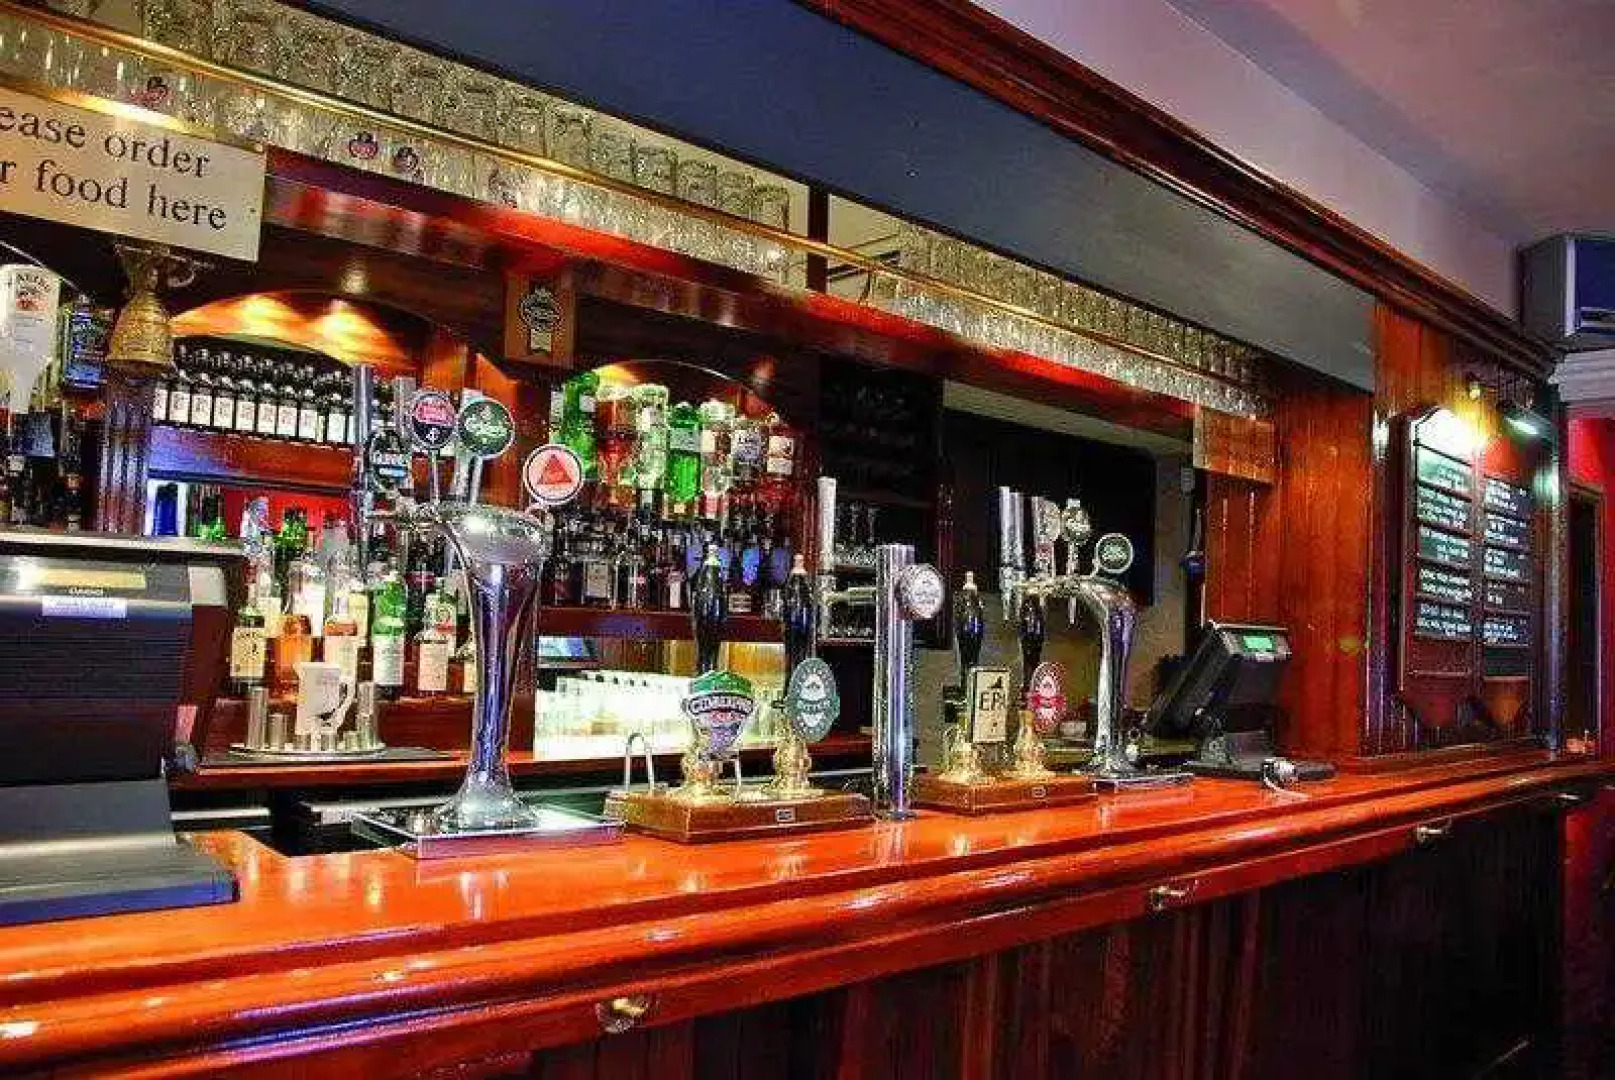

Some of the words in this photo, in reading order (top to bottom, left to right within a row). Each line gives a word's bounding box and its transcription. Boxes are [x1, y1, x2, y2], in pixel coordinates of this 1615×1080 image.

[0, 106, 86, 148] ease
[104, 133, 210, 178] order
[34, 160, 128, 209] food
[148, 183, 227, 230] here
